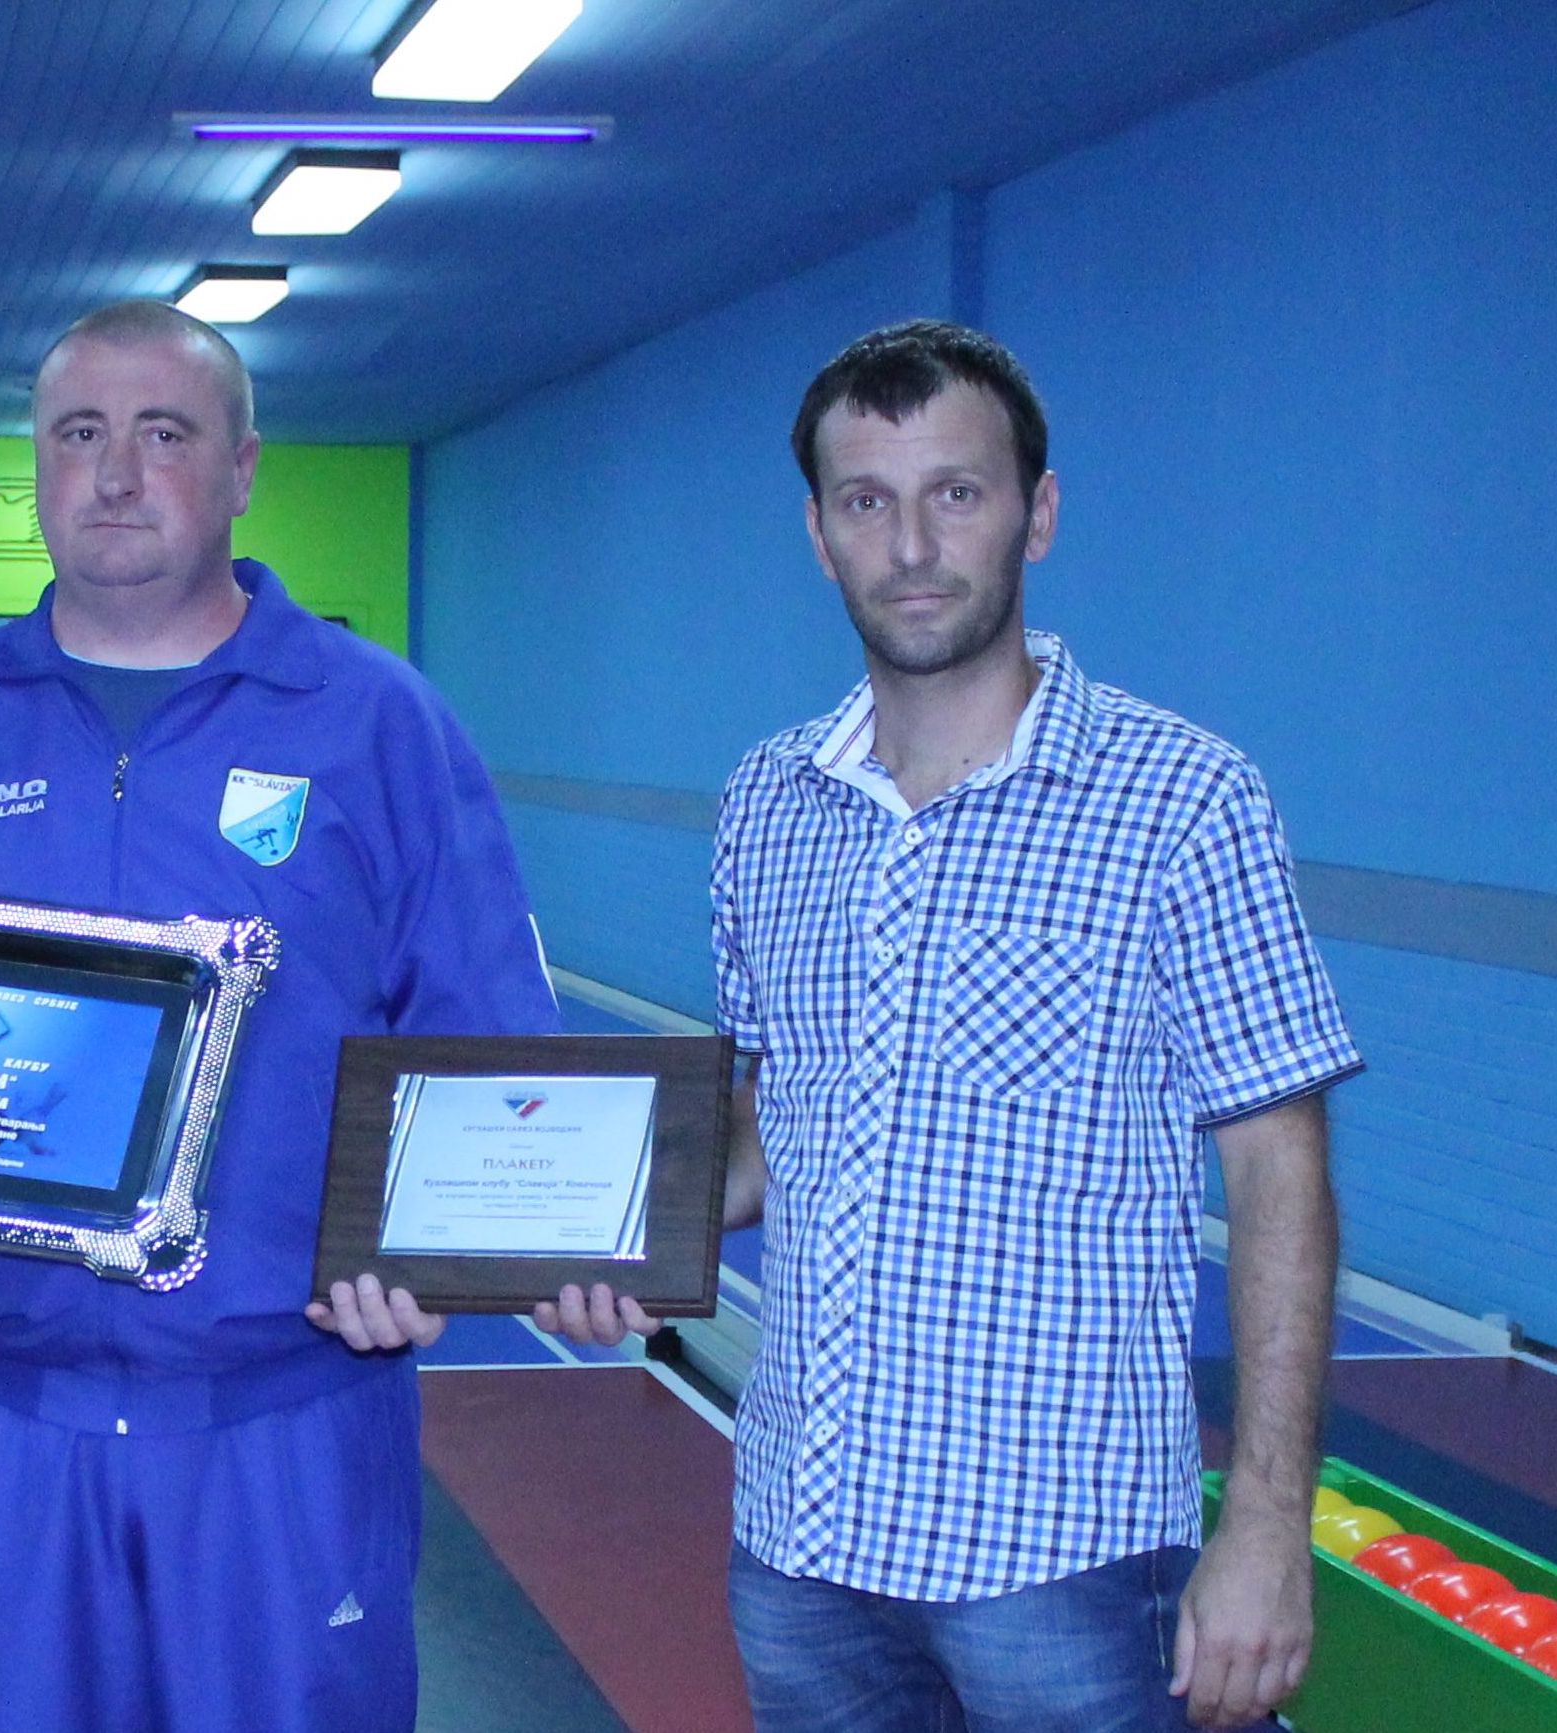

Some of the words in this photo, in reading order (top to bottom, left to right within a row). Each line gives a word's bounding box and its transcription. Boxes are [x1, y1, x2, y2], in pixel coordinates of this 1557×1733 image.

[232, 774, 246, 785] KK
[3, 1057, 51, 1073] КЛУБУ
[482, 1158, 556, 1170] ПЛАКЕТУ
